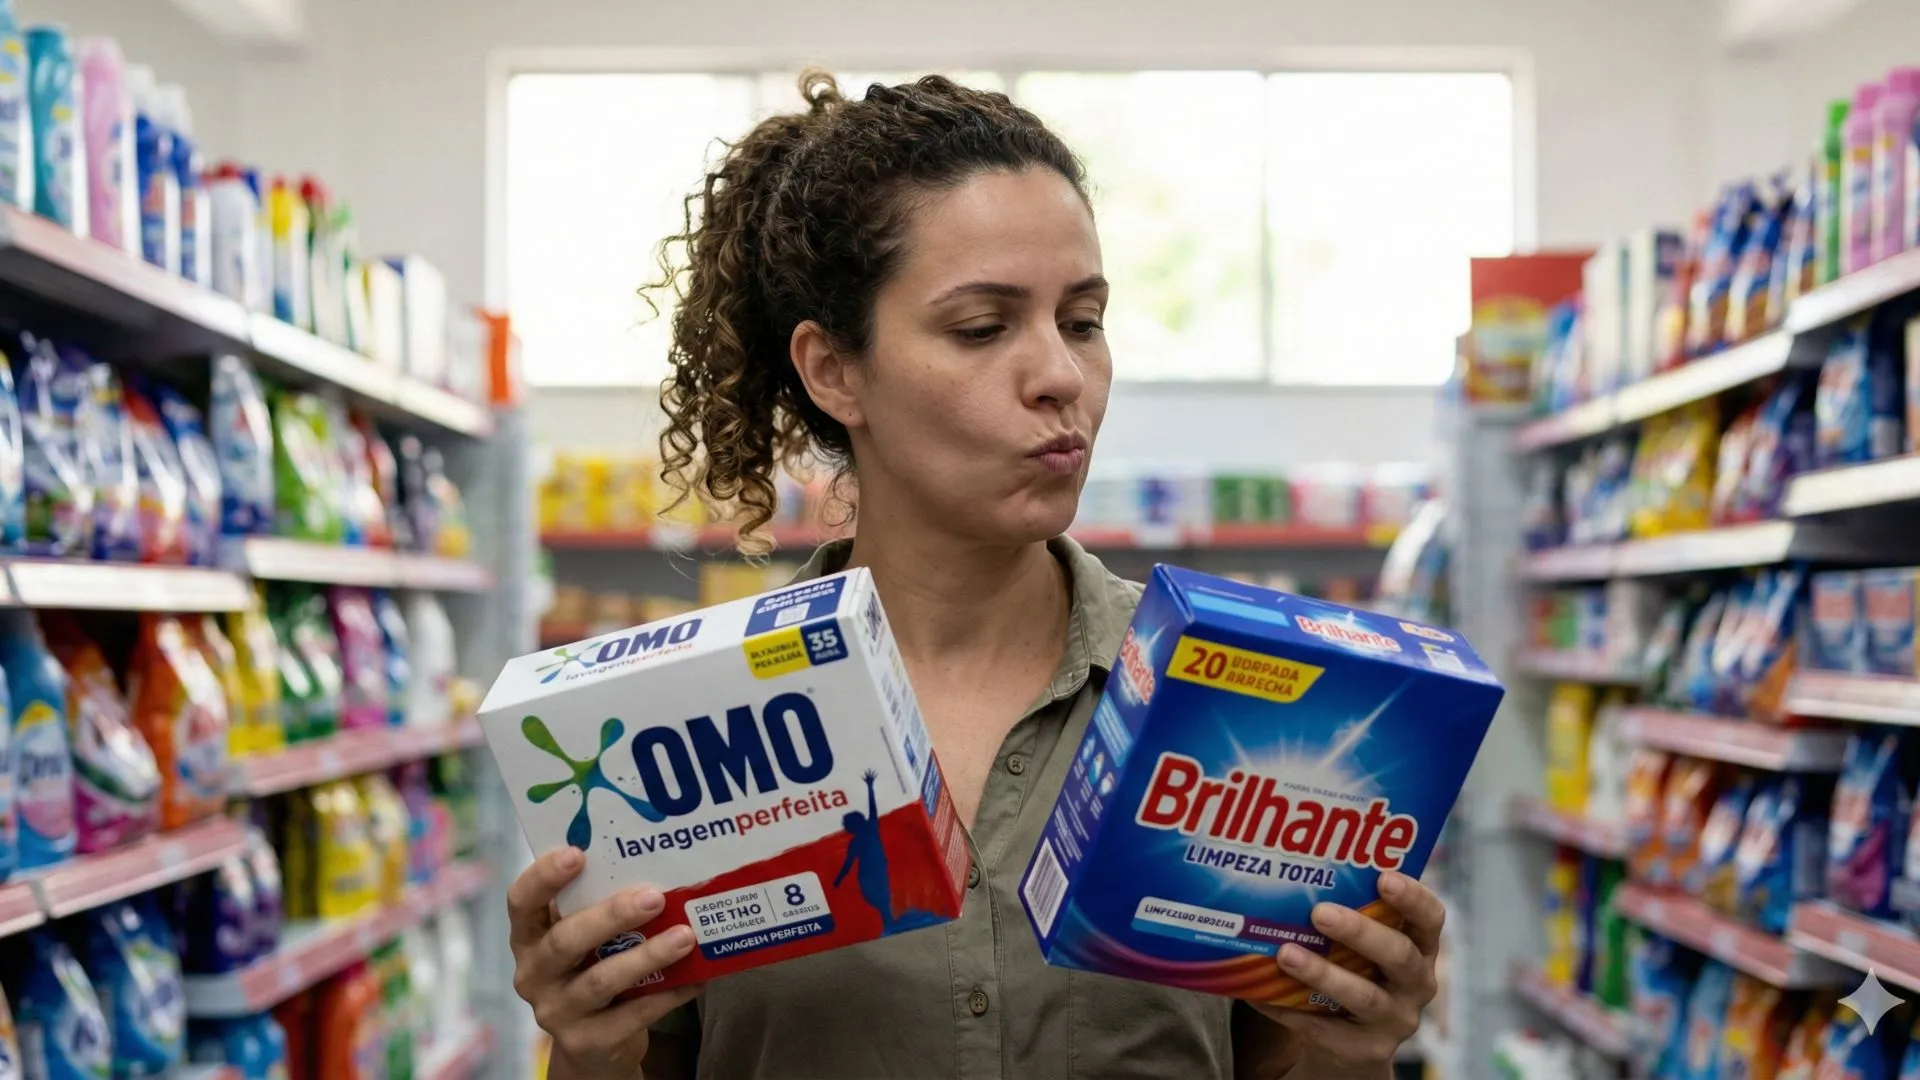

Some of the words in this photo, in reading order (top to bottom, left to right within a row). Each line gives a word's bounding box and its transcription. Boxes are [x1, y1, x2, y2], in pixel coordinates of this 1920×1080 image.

[596, 618, 703, 663] OMO
[807, 628, 838, 651] 35
[1183, 646, 1228, 680] 20
[631, 692, 834, 817] OMO
[615, 789, 849, 858] lavagemperfeita
[1140, 755, 1415, 869] Brilhante
[1185, 844, 1272, 877] LIMPEZA
[1277, 861, 1336, 888] TOTAL
[783, 883, 806, 906] 8
[769, 921, 822, 943] PERFEITA
